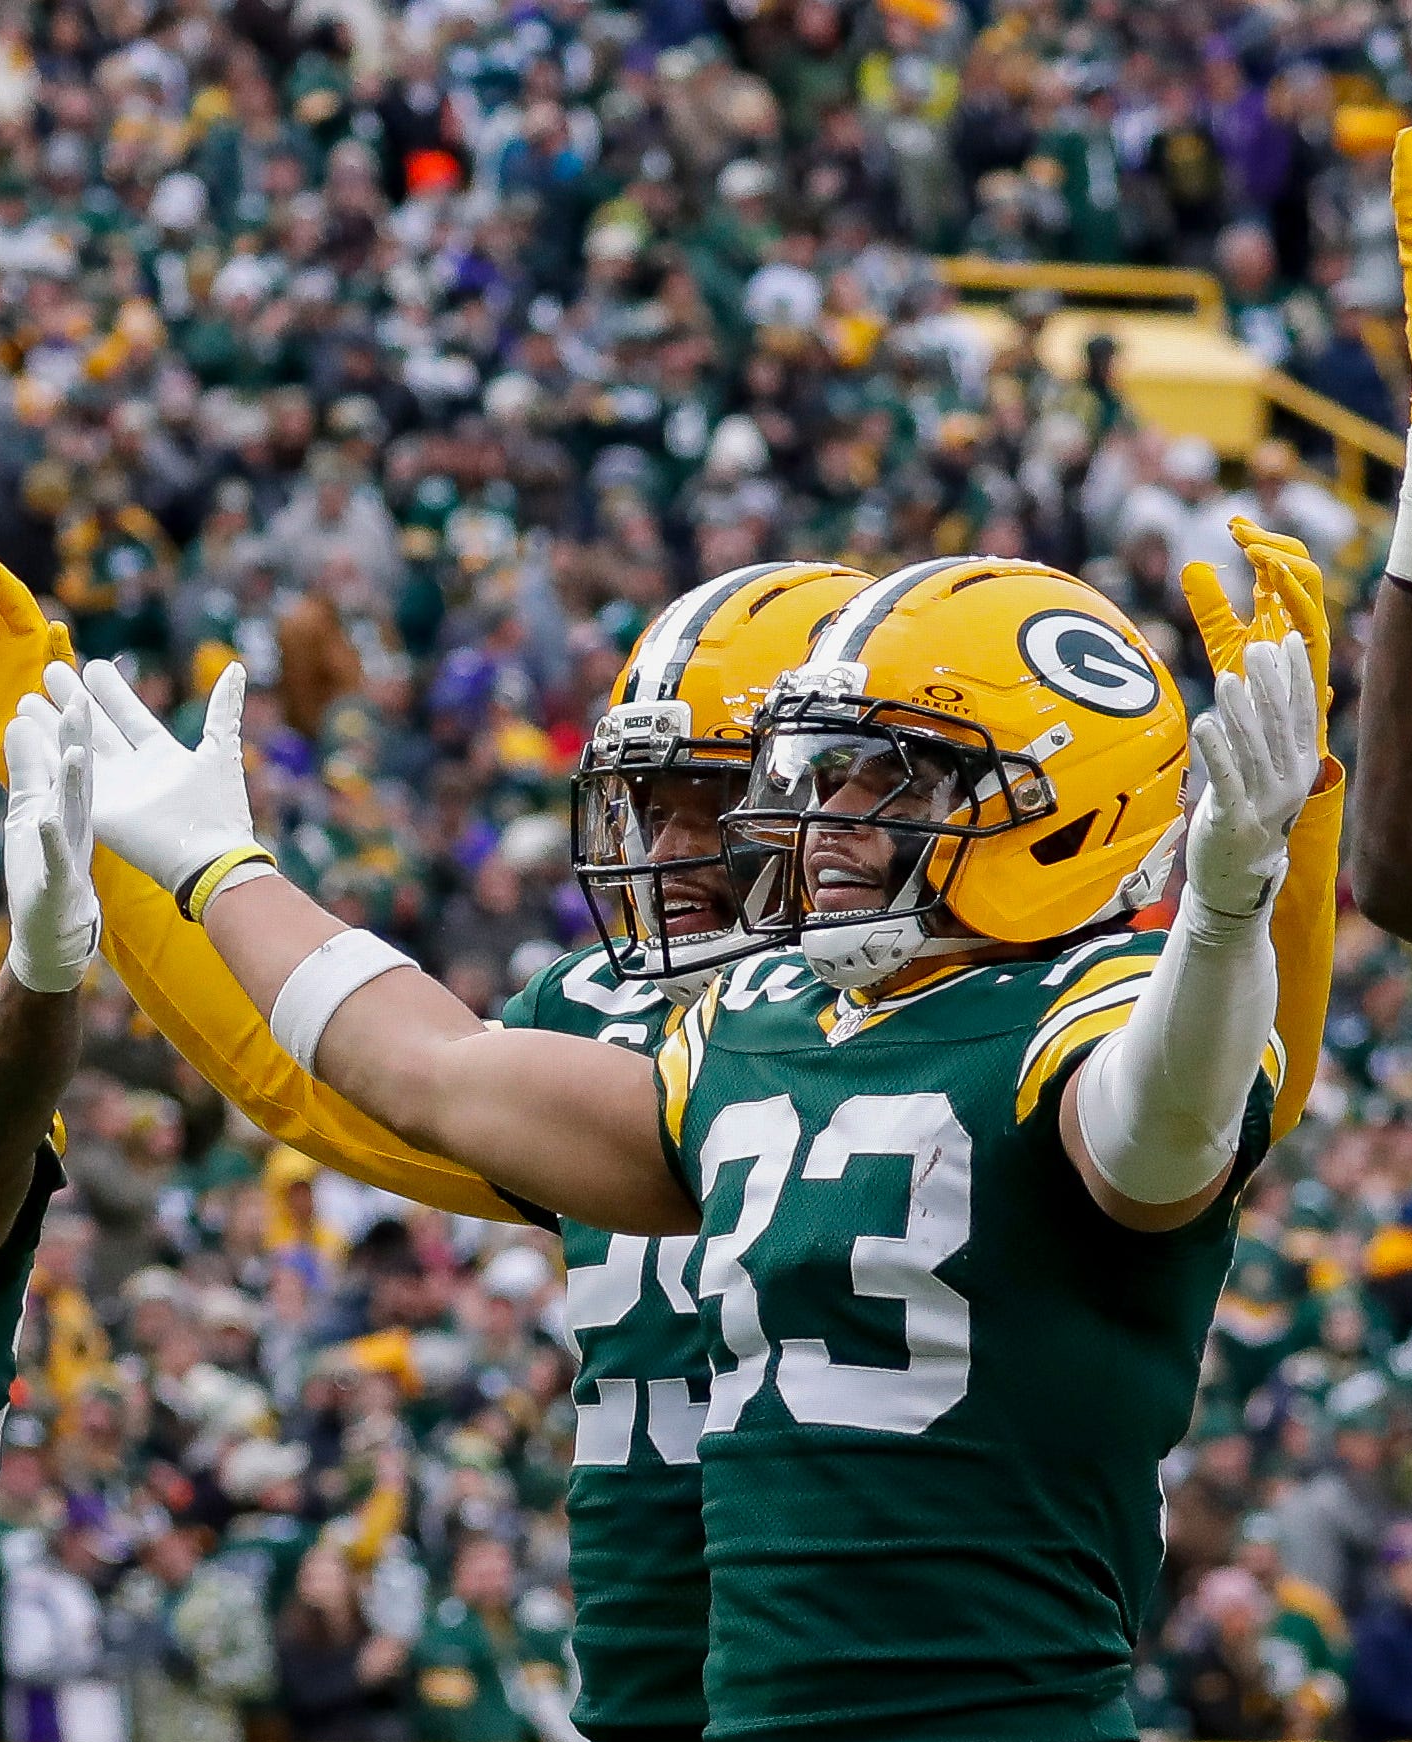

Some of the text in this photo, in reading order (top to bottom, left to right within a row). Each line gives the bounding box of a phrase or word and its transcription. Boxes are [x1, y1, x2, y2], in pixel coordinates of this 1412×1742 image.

[912, 697, 970, 714] OAKLEY
[1018, 609, 1160, 718] G
[699, 1092, 972, 1434] 33
